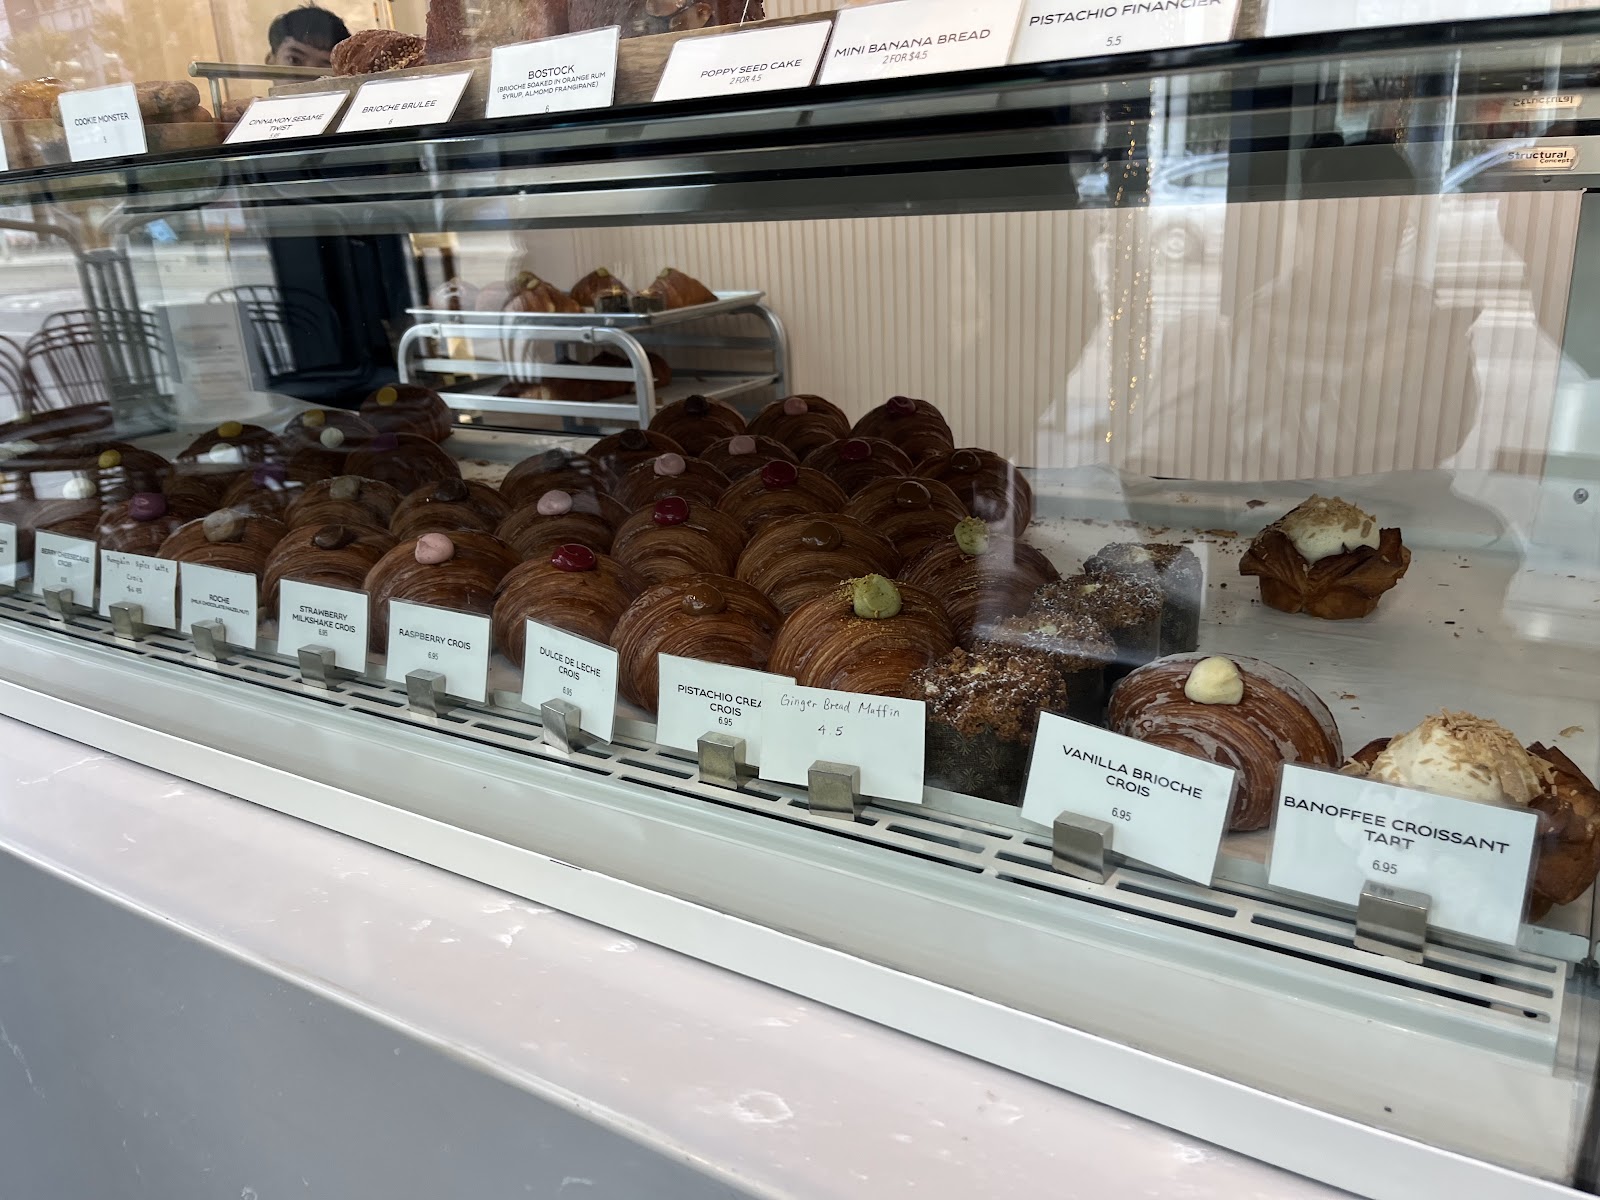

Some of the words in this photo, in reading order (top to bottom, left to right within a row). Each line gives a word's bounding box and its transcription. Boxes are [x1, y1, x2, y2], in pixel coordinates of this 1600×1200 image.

[1029, 6, 1117, 26] PISTACHIO
[834, 45, 865, 58] MINI
[867, 36, 933, 54] BANANA
[936, 29, 991, 44] BREAD
[1106, 36, 1122, 47] 5.5
[882, 56, 890, 64] 2
[890, 53, 907, 63] FOR
[908, 50, 929, 62] $4.5
[528, 64, 575, 79] BOSTOCK
[700, 67, 738, 78] POPPY
[738, 64, 768, 74] SEED
[770, 58, 802, 70] CAKE
[497, 81, 526, 92] (BRIOCHE
[527, 79, 552, 89] SOAKED
[562, 75, 589, 84] ORANGE
[591, 72, 606, 80] RUM
[735, 76, 750, 84] FOR
[502, 91, 524, 99] SYRUP,
[362, 102, 400, 114] BRIOCHE
[401, 100, 437, 110] BRULEE
[74, 116, 97, 126] COOKIE
[98, 112, 129, 123] MONSTER
[248, 117, 291, 126] CINNAMON
[292, 114, 324, 122] SESAME
[1508, 150, 1567, 160] Structural
[209, 594, 230, 604] ROCHE
[300, 606, 348, 620] STRAWBERRY
[292, 614, 334, 628] MILKSHAKE
[335, 622, 356, 633] CROIS
[398, 628, 446, 645] RASPBERRY
[447, 638, 471, 650] CROIS
[428, 652, 438, 660] 6.95
[540, 646, 563, 663] DULCE
[564, 657, 574, 667] DE
[577, 660, 601, 678] LECHE
[558, 666, 580, 681] CROIS
[678, 684, 733, 702] PISTACHIO
[710, 702, 742, 717] CROIS
[780, 694, 817, 712] Ginger
[824, 698, 850, 713] Bread
[718, 716, 733, 727] 6.95
[1062, 745, 1128, 776] VANILLA
[1132, 768, 1203, 800] BRIOCHE
[1106, 775, 1150, 797] CROIS
[1112, 807, 1132, 822] 6.95
[1284, 796, 1387, 828] BANOFFEE
[1391, 820, 1510, 854] CROISSANT
[1364, 830, 1415, 850] TART
[1372, 860, 1398, 875] 6.95
